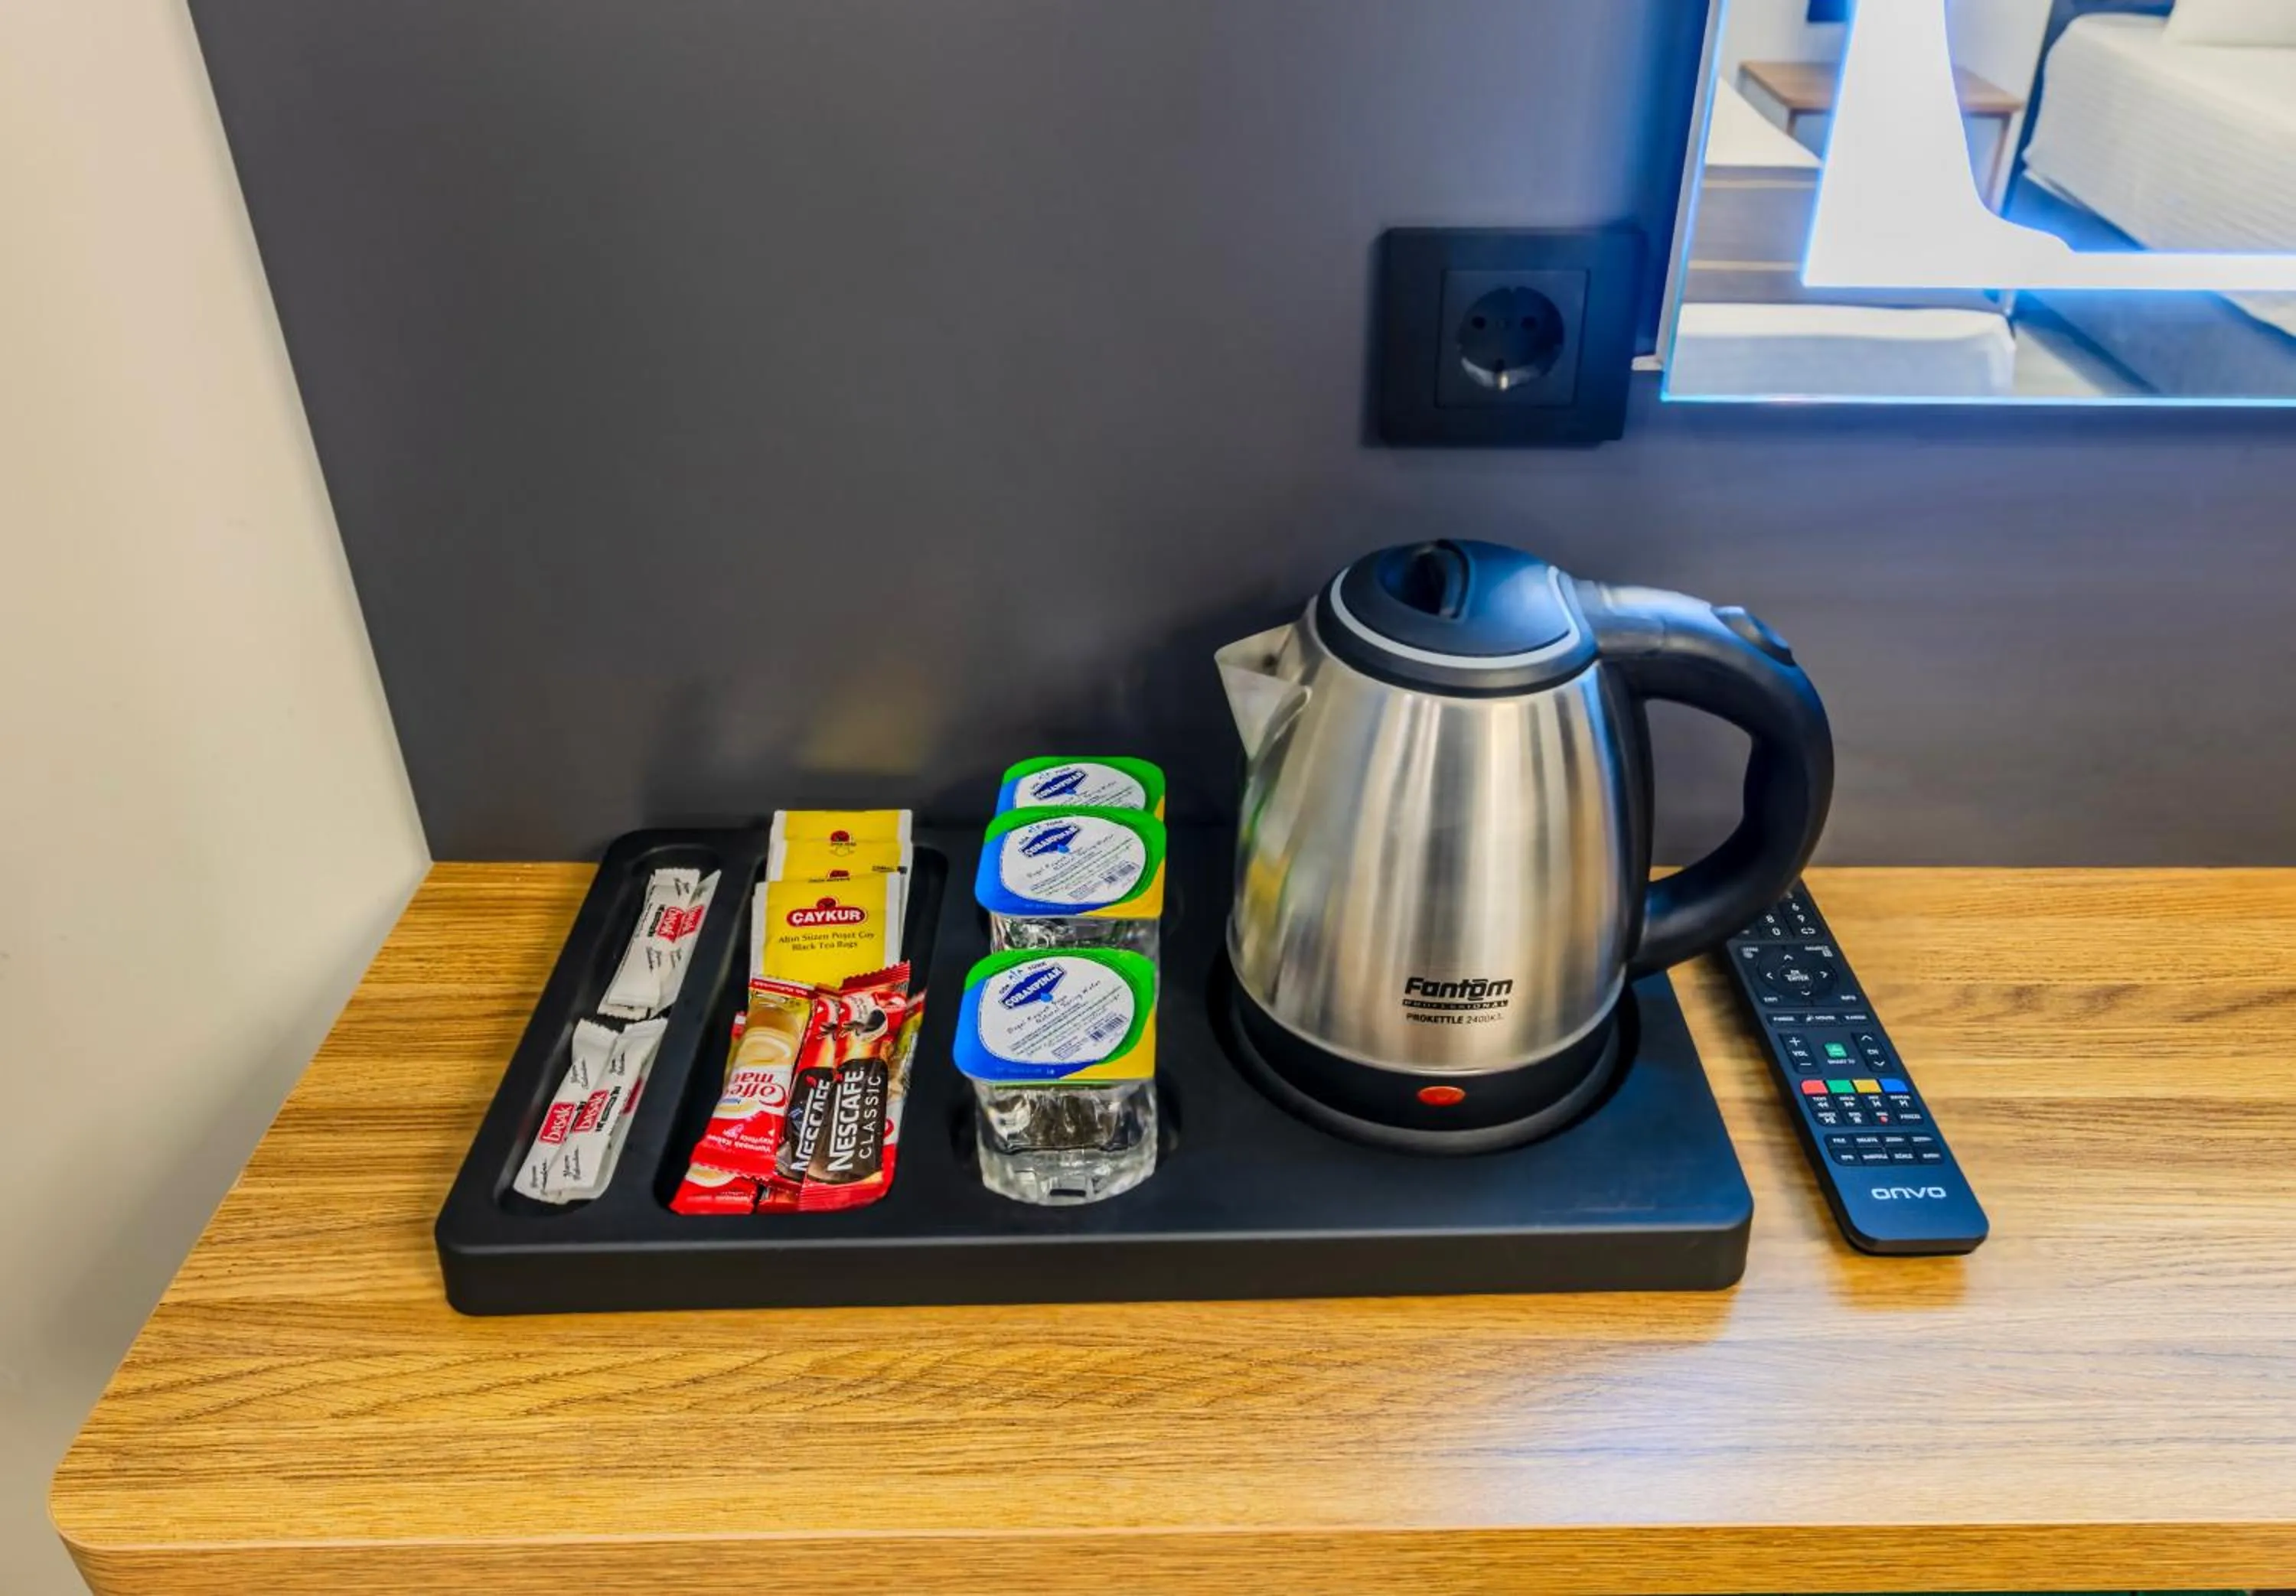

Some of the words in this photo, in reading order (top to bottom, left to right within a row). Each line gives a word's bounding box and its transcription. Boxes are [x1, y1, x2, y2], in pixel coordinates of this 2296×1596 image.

[1766, 915, 1775, 923] 8
[1773, 928, 1781, 936] 0
[819, 942, 835, 950] Tea
[1406, 1012, 1463, 1024] PROKETTLE
[859, 1076, 881, 1159] CLASSIC
